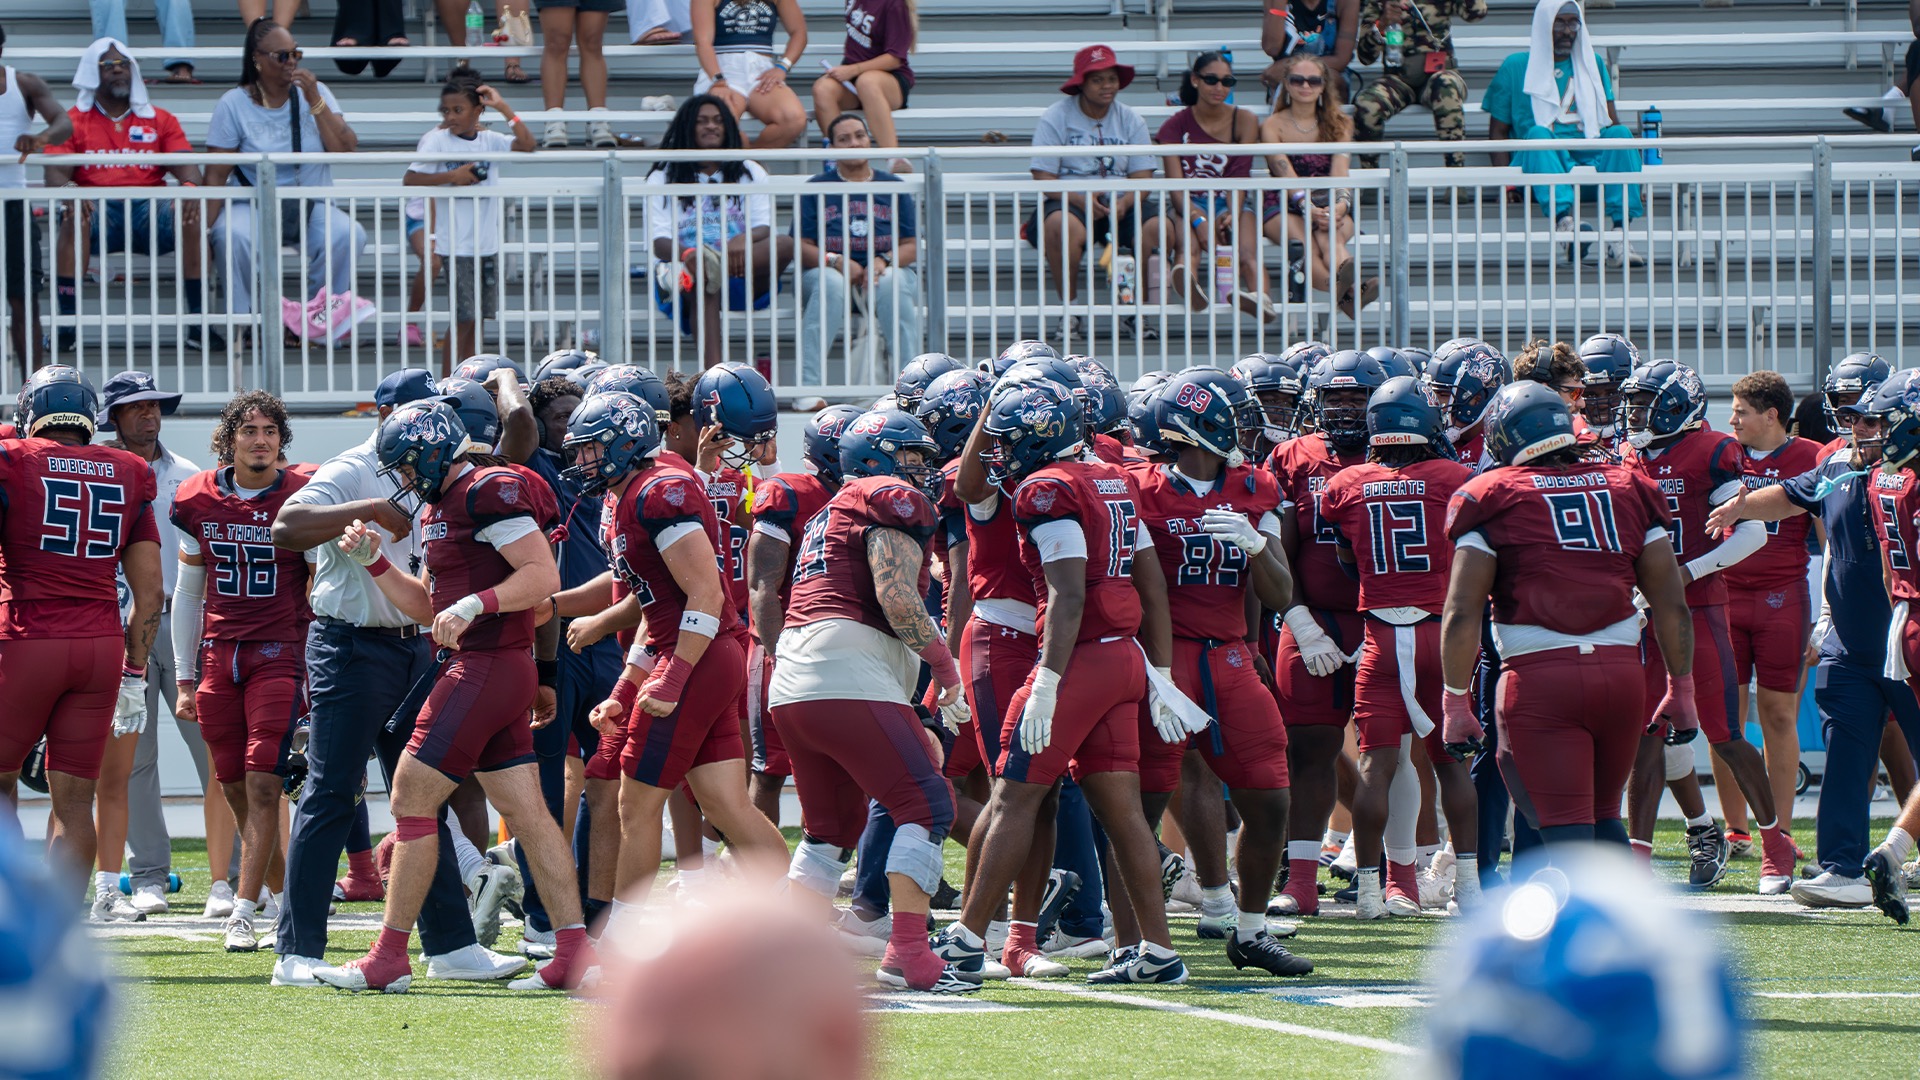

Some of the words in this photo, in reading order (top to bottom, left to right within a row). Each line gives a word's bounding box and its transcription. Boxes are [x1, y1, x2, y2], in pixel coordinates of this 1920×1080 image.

[461, 365, 478, 379] 71
[1176, 384, 1212, 413] 89
[52, 413, 81, 423] schutt
[818, 413, 846, 438] 21
[1375, 435, 1411, 444] Riddell
[1525, 436, 1567, 456] Riddell
[47, 456, 115, 478] BOBCATS
[1363, 480, 1425, 498] BOBCATS
[1531, 471, 1607, 489] BOBCATS
[1658, 478, 1685, 494] MAS
[1742, 474, 1781, 488] THOM
[40, 477, 125, 558] 55
[1166, 518, 1193, 534] ST.
[1542, 489, 1623, 553] 91
[201, 522, 223, 539] ST.
[227, 523, 272, 542] THOMA
[1104, 500, 1136, 577] 15
[1366, 500, 1430, 574] 12
[1879, 494, 1910, 570] 3
[209, 541, 277, 597] 36
[1178, 533, 1247, 587] 89
